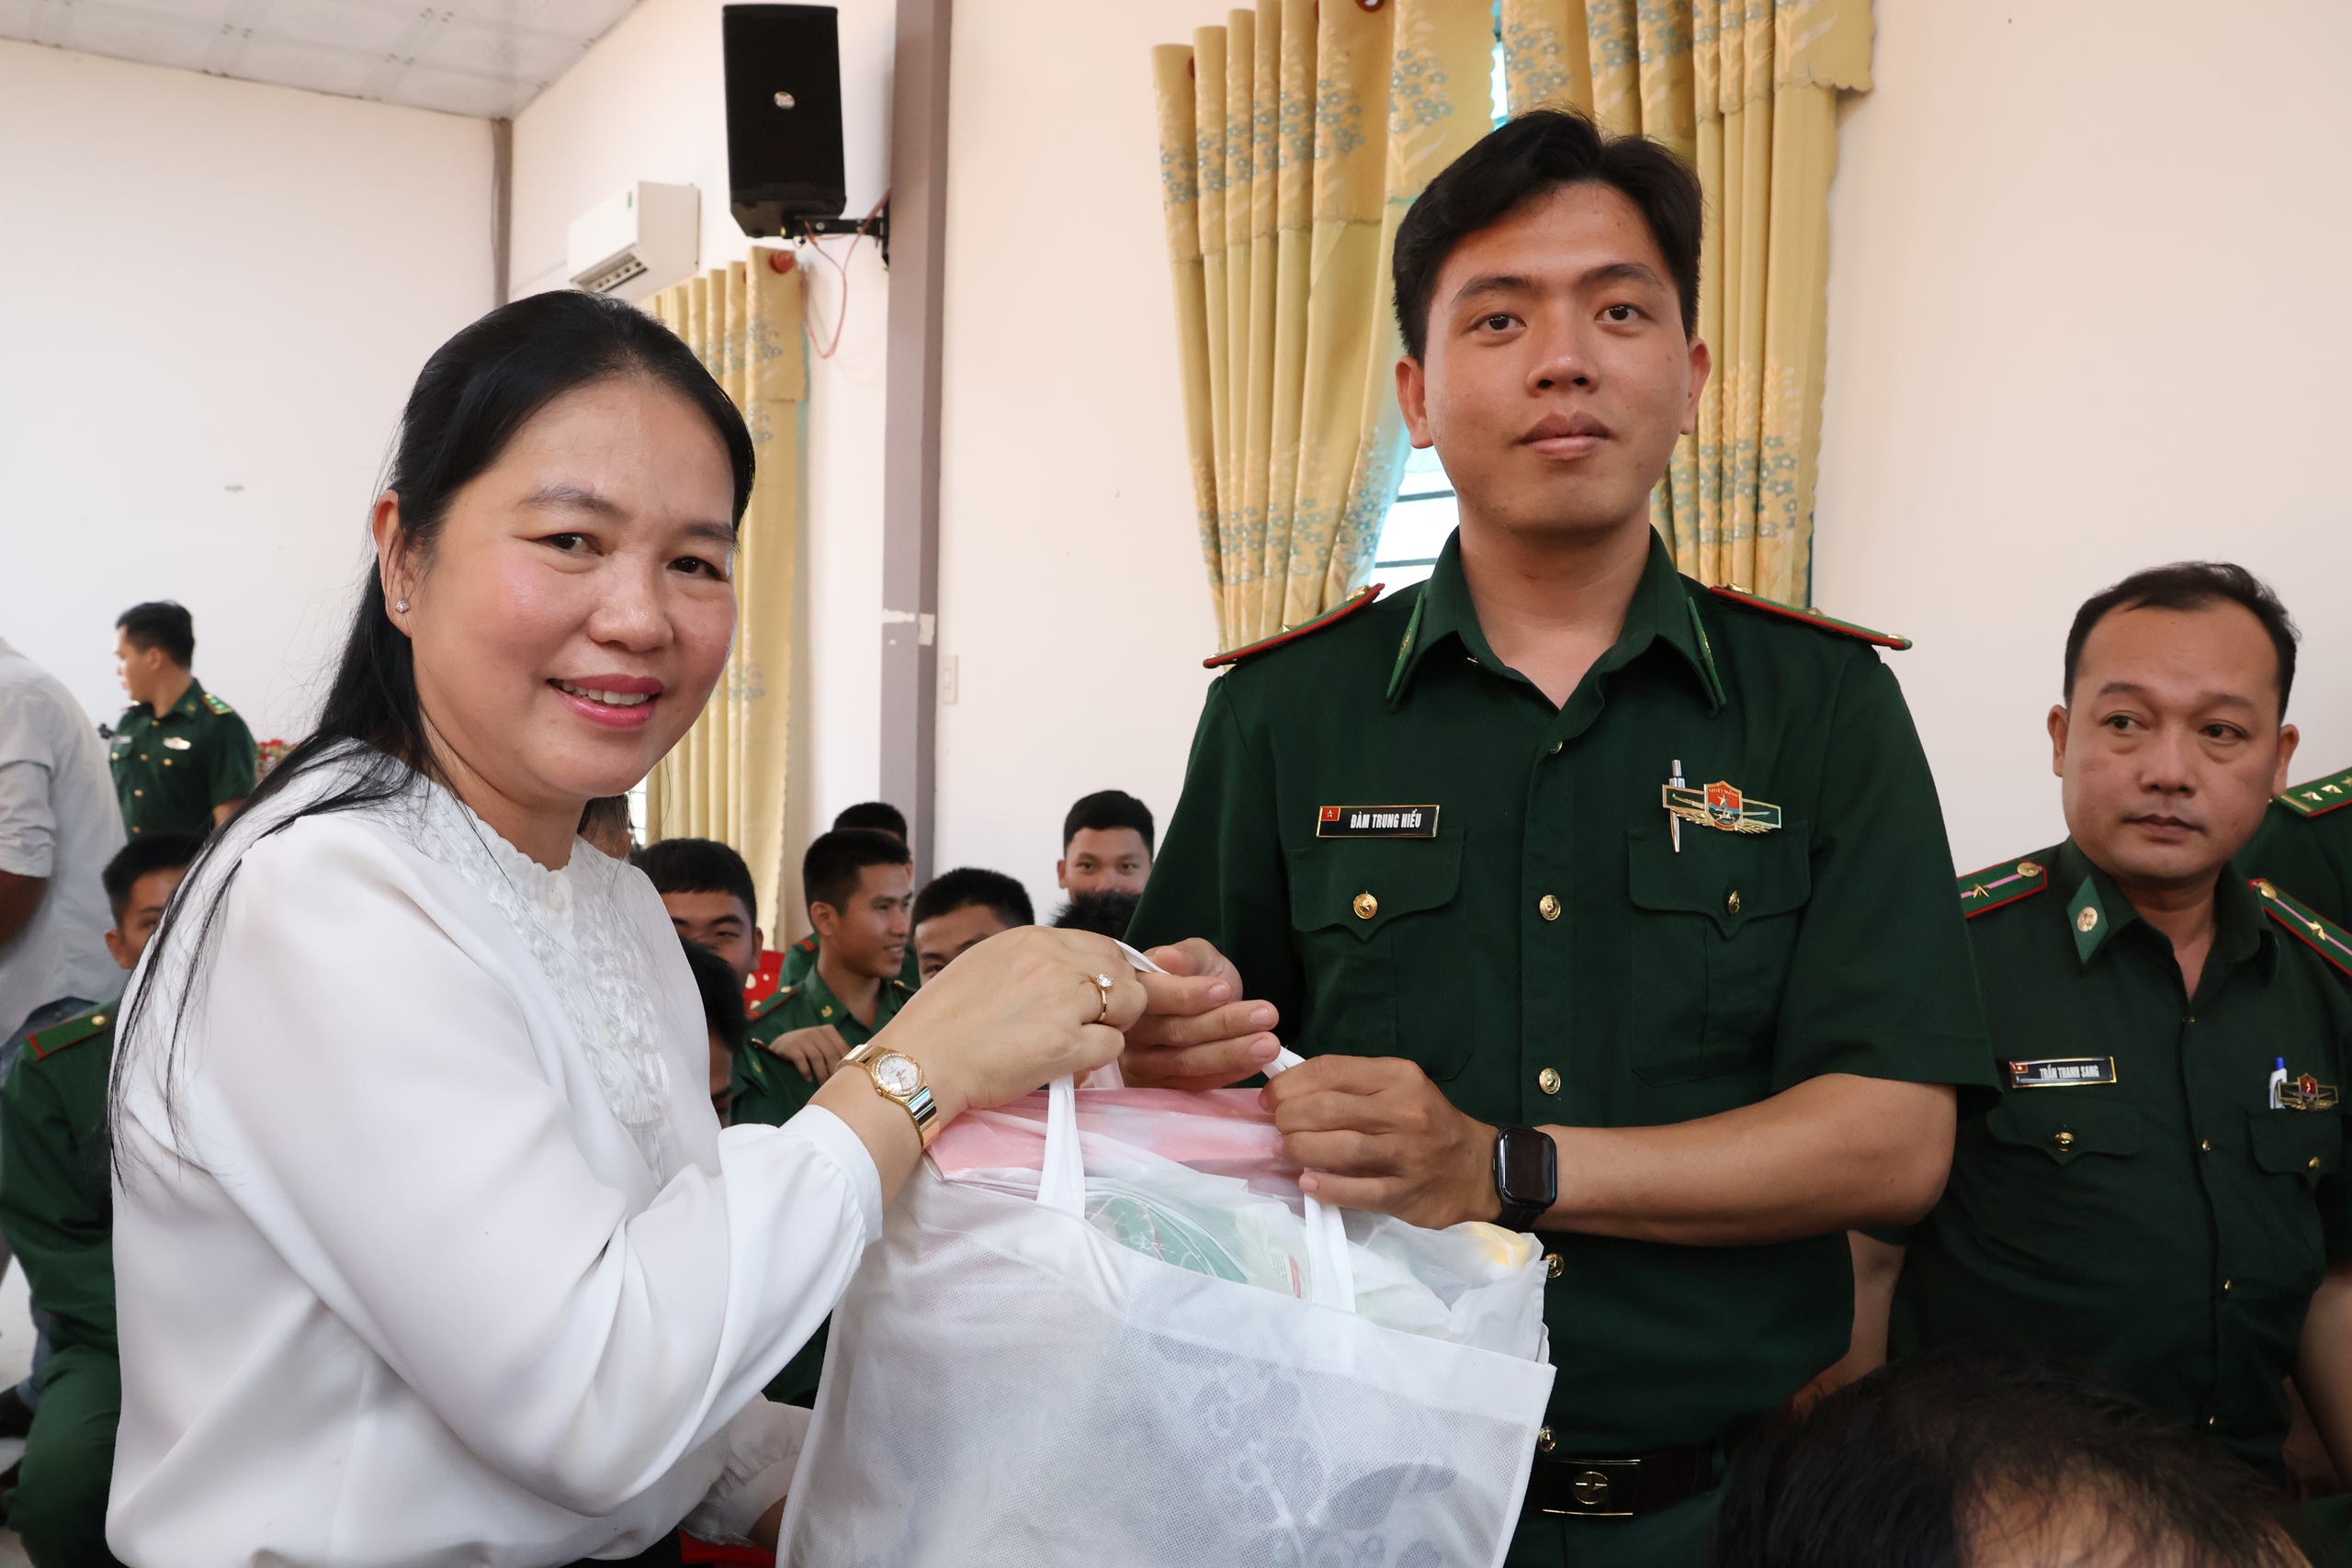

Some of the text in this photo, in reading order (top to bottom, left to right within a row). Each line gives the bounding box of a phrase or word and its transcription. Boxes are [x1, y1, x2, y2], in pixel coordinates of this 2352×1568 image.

[1350, 808, 1422, 829] ĐÀM TRUNG HIẾU
[2057, 1066, 2080, 1078] THANH
[2080, 1065, 2099, 1077] SANG
